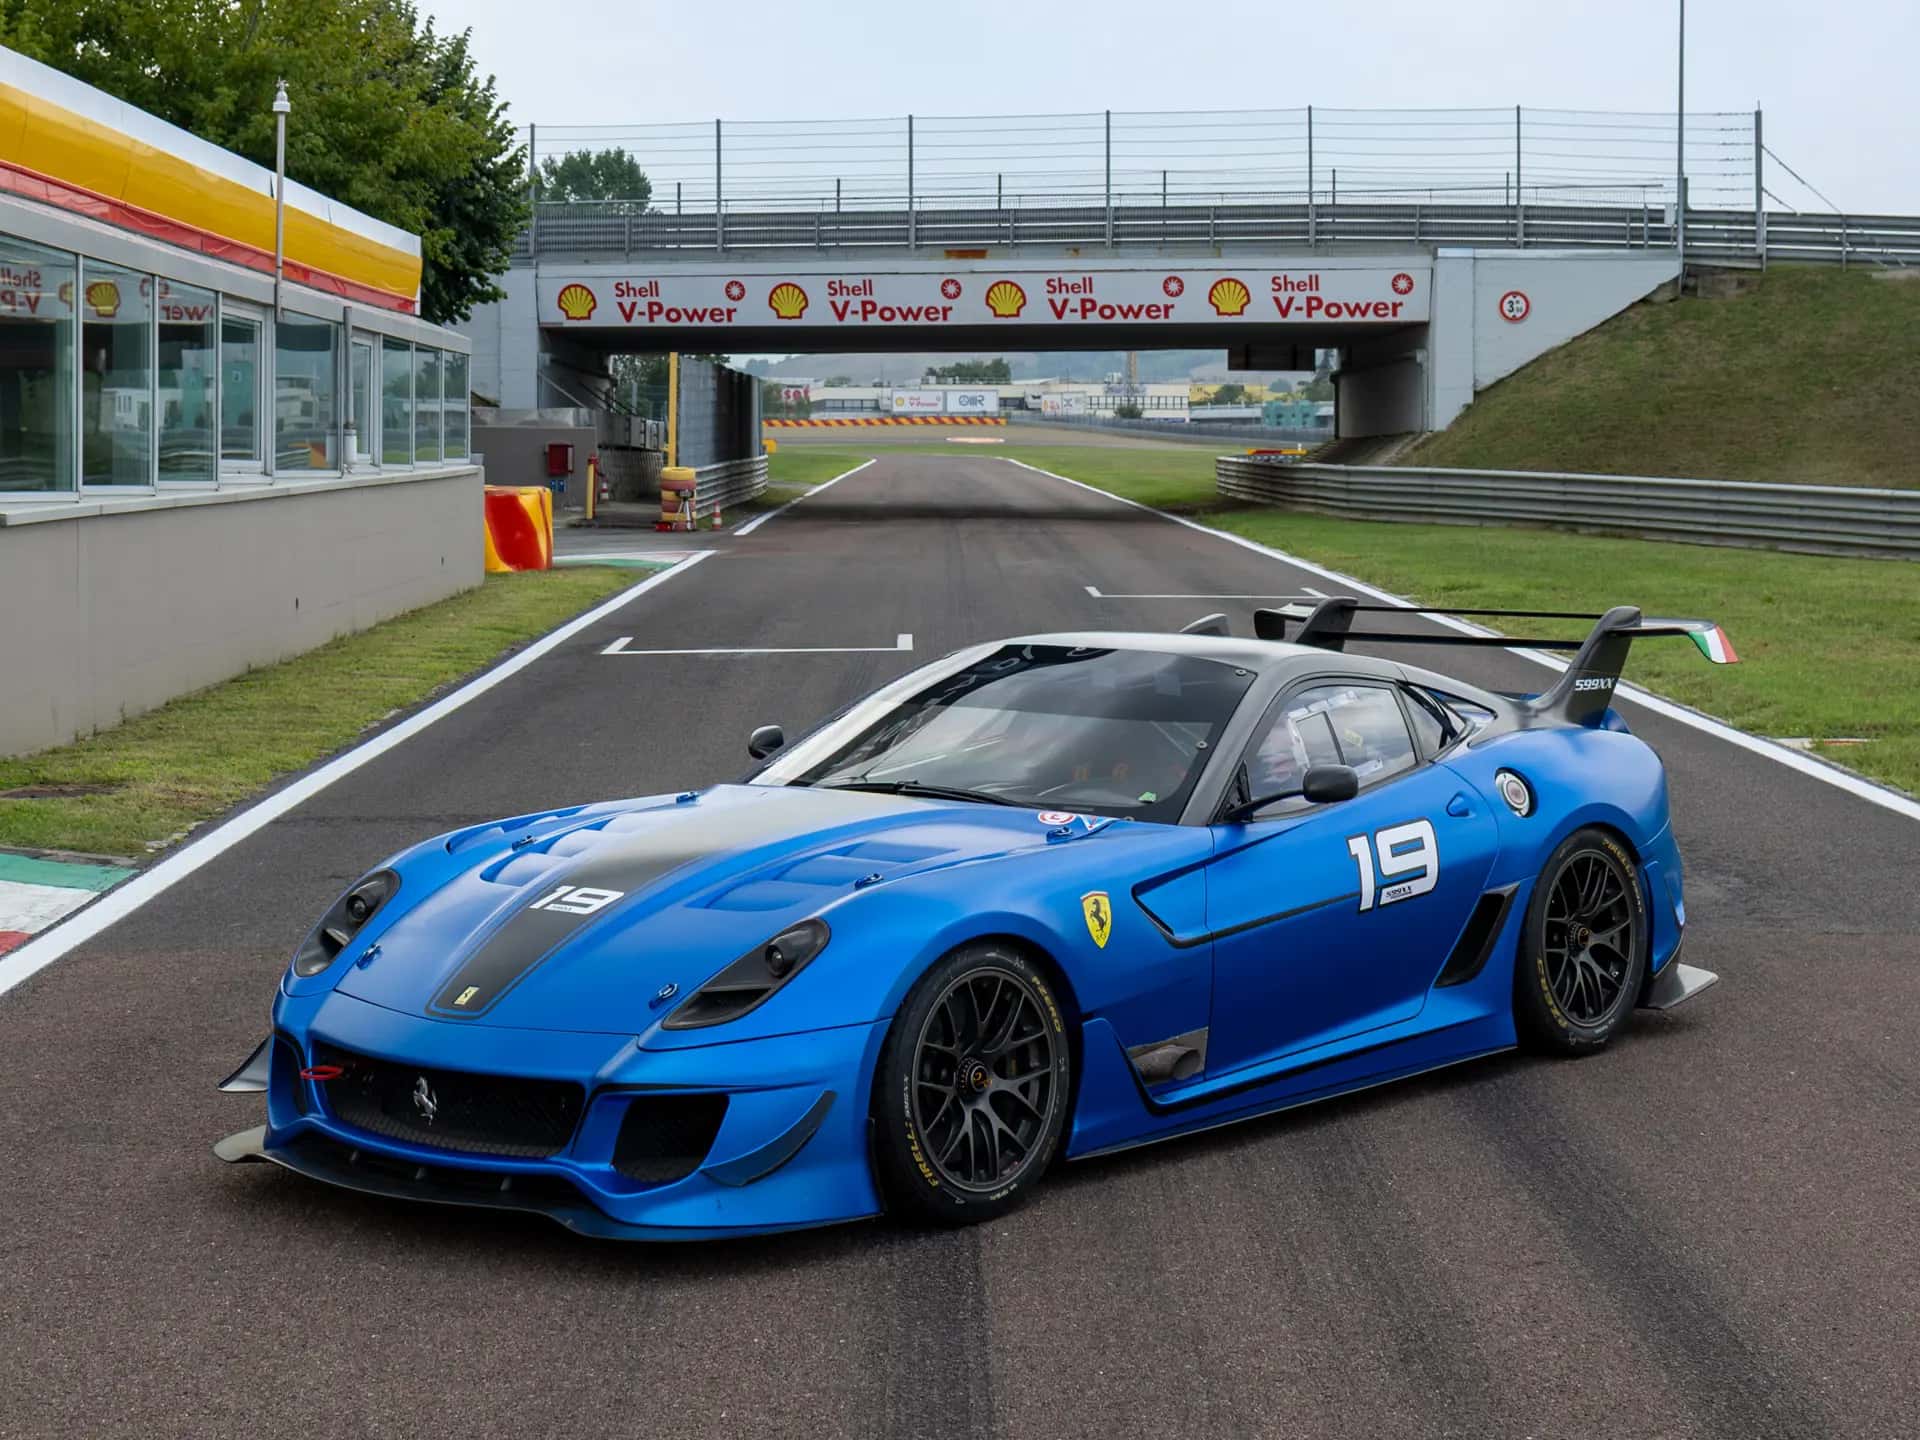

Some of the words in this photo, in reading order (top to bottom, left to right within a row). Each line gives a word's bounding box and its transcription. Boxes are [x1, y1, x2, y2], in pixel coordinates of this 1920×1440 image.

[614, 280, 660, 298] Shell
[827, 279, 873, 297] Shell
[1046, 276, 1093, 294] Shell
[1271, 274, 1319, 292] Shell
[616, 301, 738, 323] V-Power
[829, 300, 953, 322] V-Power
[1048, 298, 1175, 320] V-Power
[1272, 296, 1404, 319] V-Power
[1575, 677, 1615, 691] 599XX
[1347, 818, 1439, 912] 19
[528, 885, 625, 915] 19
